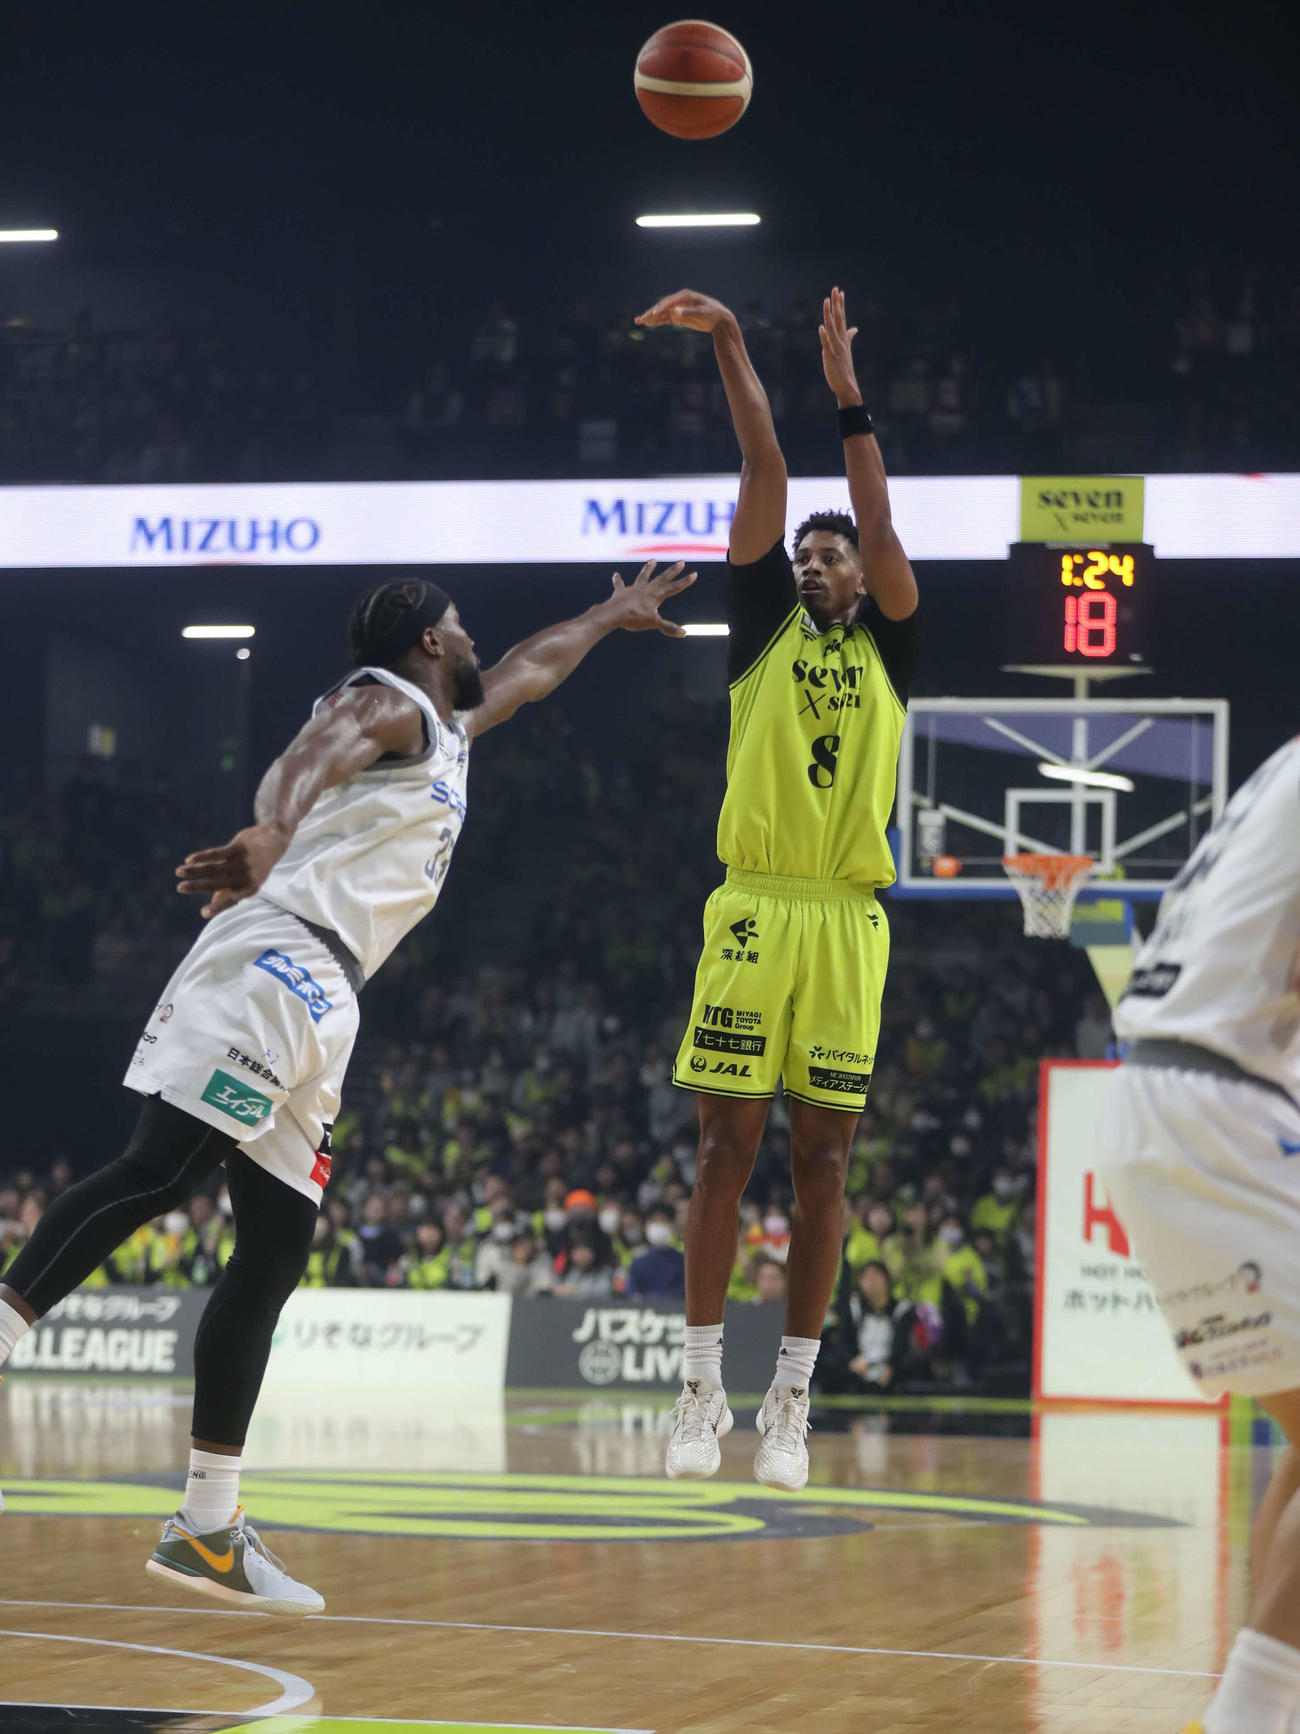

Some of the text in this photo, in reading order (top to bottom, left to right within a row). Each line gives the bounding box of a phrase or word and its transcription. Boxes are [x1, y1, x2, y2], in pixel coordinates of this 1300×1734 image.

[1037, 489, 1123, 509] seven
[131, 517, 321, 555] MIZUHO
[1060, 551, 1135, 590] 1:24
[1064, 591, 1117, 657] 18
[808, 734, 841, 789] 8
[735, 1017, 762, 1025] TOYOTA
[736, 1010, 762, 1018] MIYAGI
[703, 1035, 762, 1052] 七十七銀行
[709, 1061, 752, 1078] JAL
[215, 1085, 266, 1119] エイブル
[8, 1326, 179, 1373] B.LEAGUE
[293, 1319, 488, 1353] りそなグループ
[621, 1345, 687, 1382] LIV
